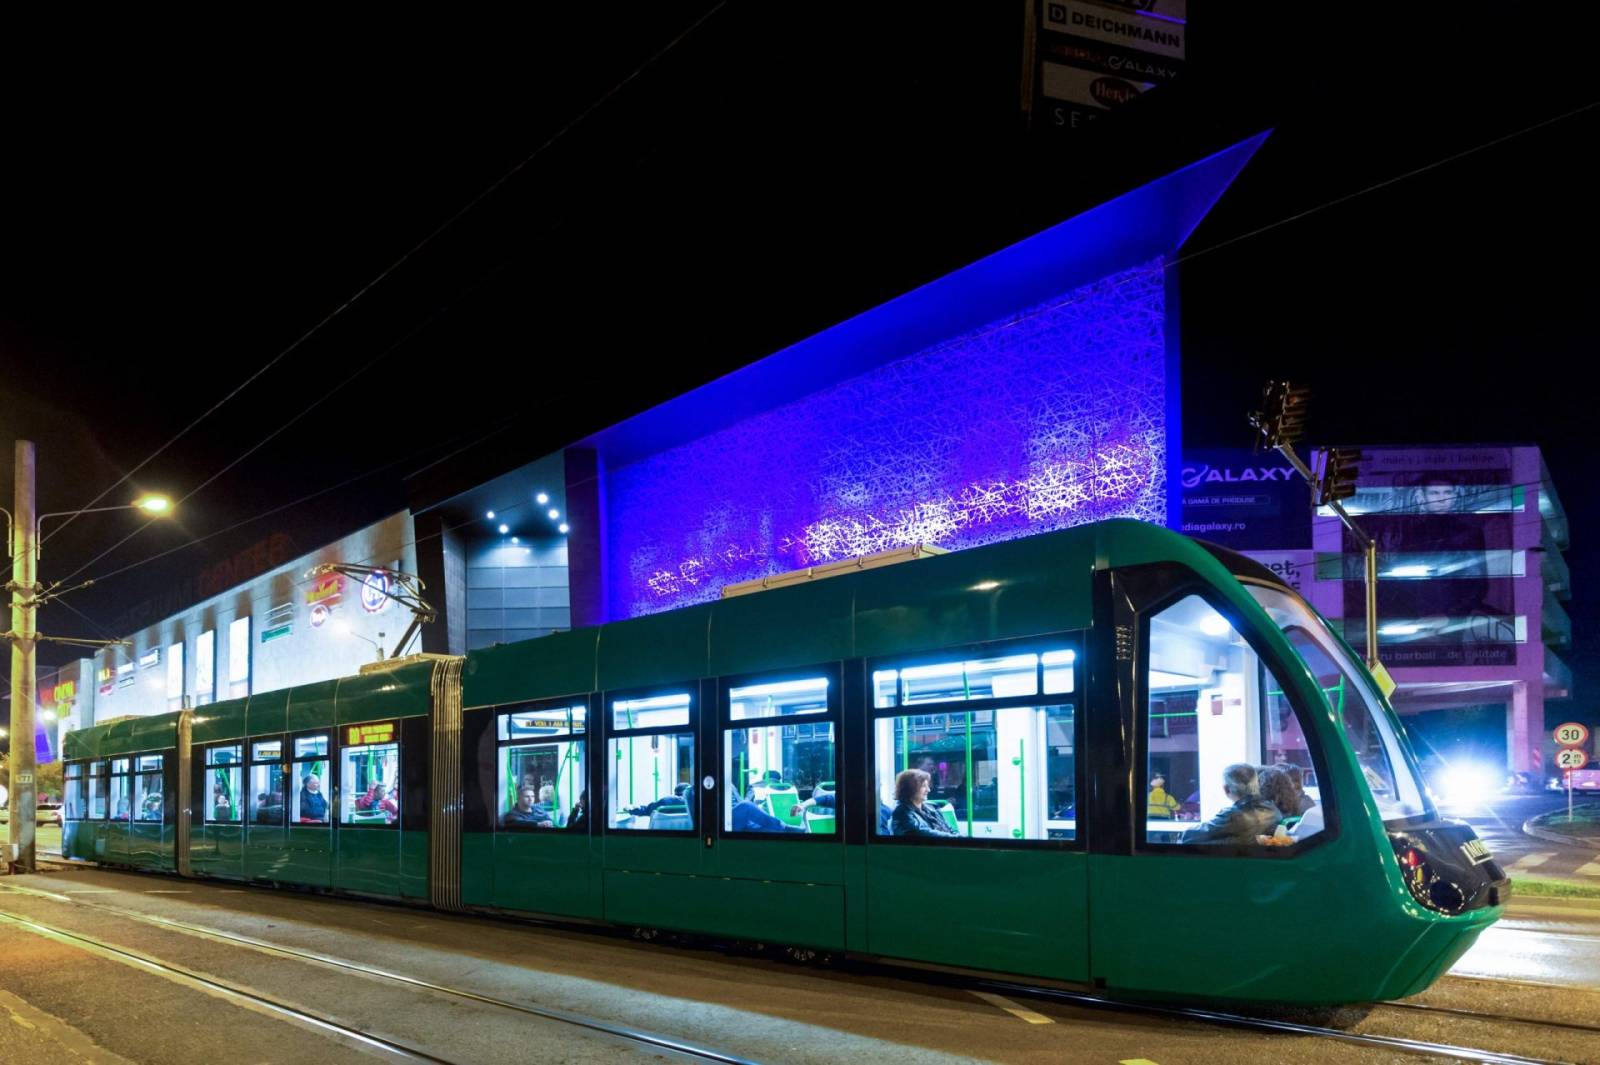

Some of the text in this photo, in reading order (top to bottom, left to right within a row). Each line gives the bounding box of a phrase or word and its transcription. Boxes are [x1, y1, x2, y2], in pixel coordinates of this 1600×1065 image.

[1072, 12, 1180, 47] DEICHMANN
[1107, 55, 1177, 80] GALAXY
[1181, 464, 1296, 488] GALAXY
[1561, 729, 1580, 741] 30
